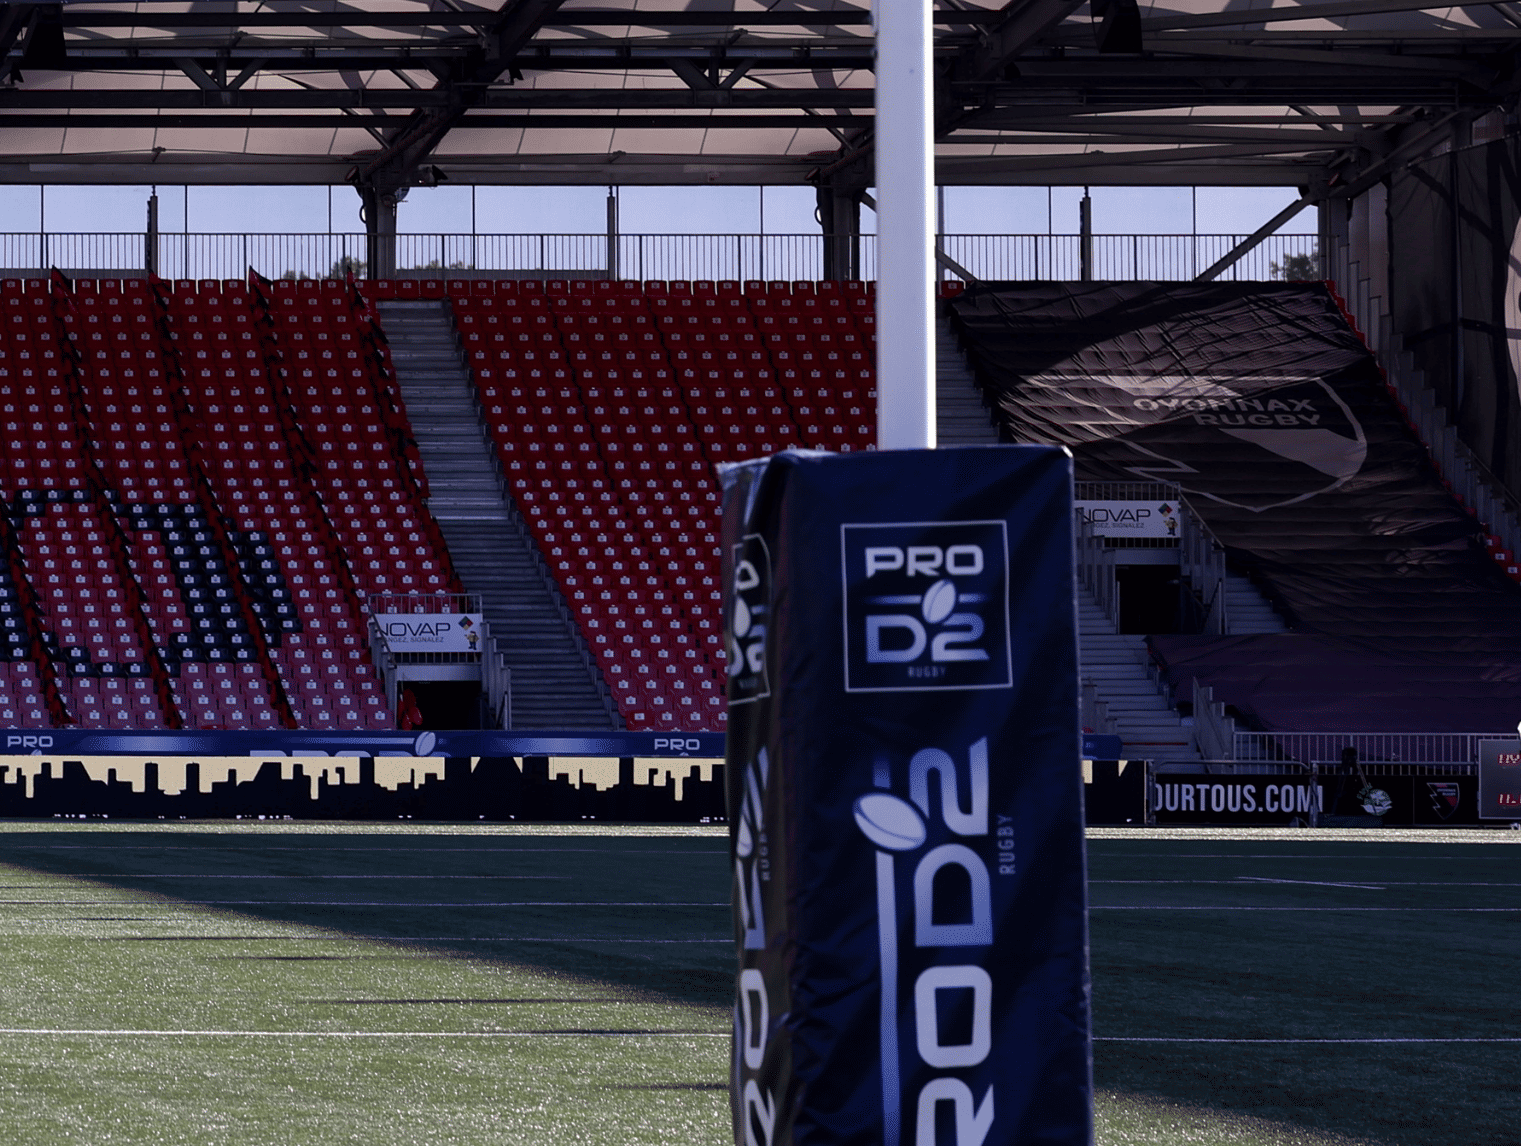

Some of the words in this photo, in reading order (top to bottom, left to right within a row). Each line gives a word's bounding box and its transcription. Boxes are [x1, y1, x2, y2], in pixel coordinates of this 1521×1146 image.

[1133, 398, 1318, 412] OYONNAX
[1193, 413, 1321, 426] RUGBY
[864, 544, 985, 579] PRO
[865, 612, 990, 664] D2
[907, 665, 947, 678] RUGBY
[7, 735, 54, 748] PRO
[654, 738, 701, 751] PRO
[997, 813, 1016, 876] RUGBY
